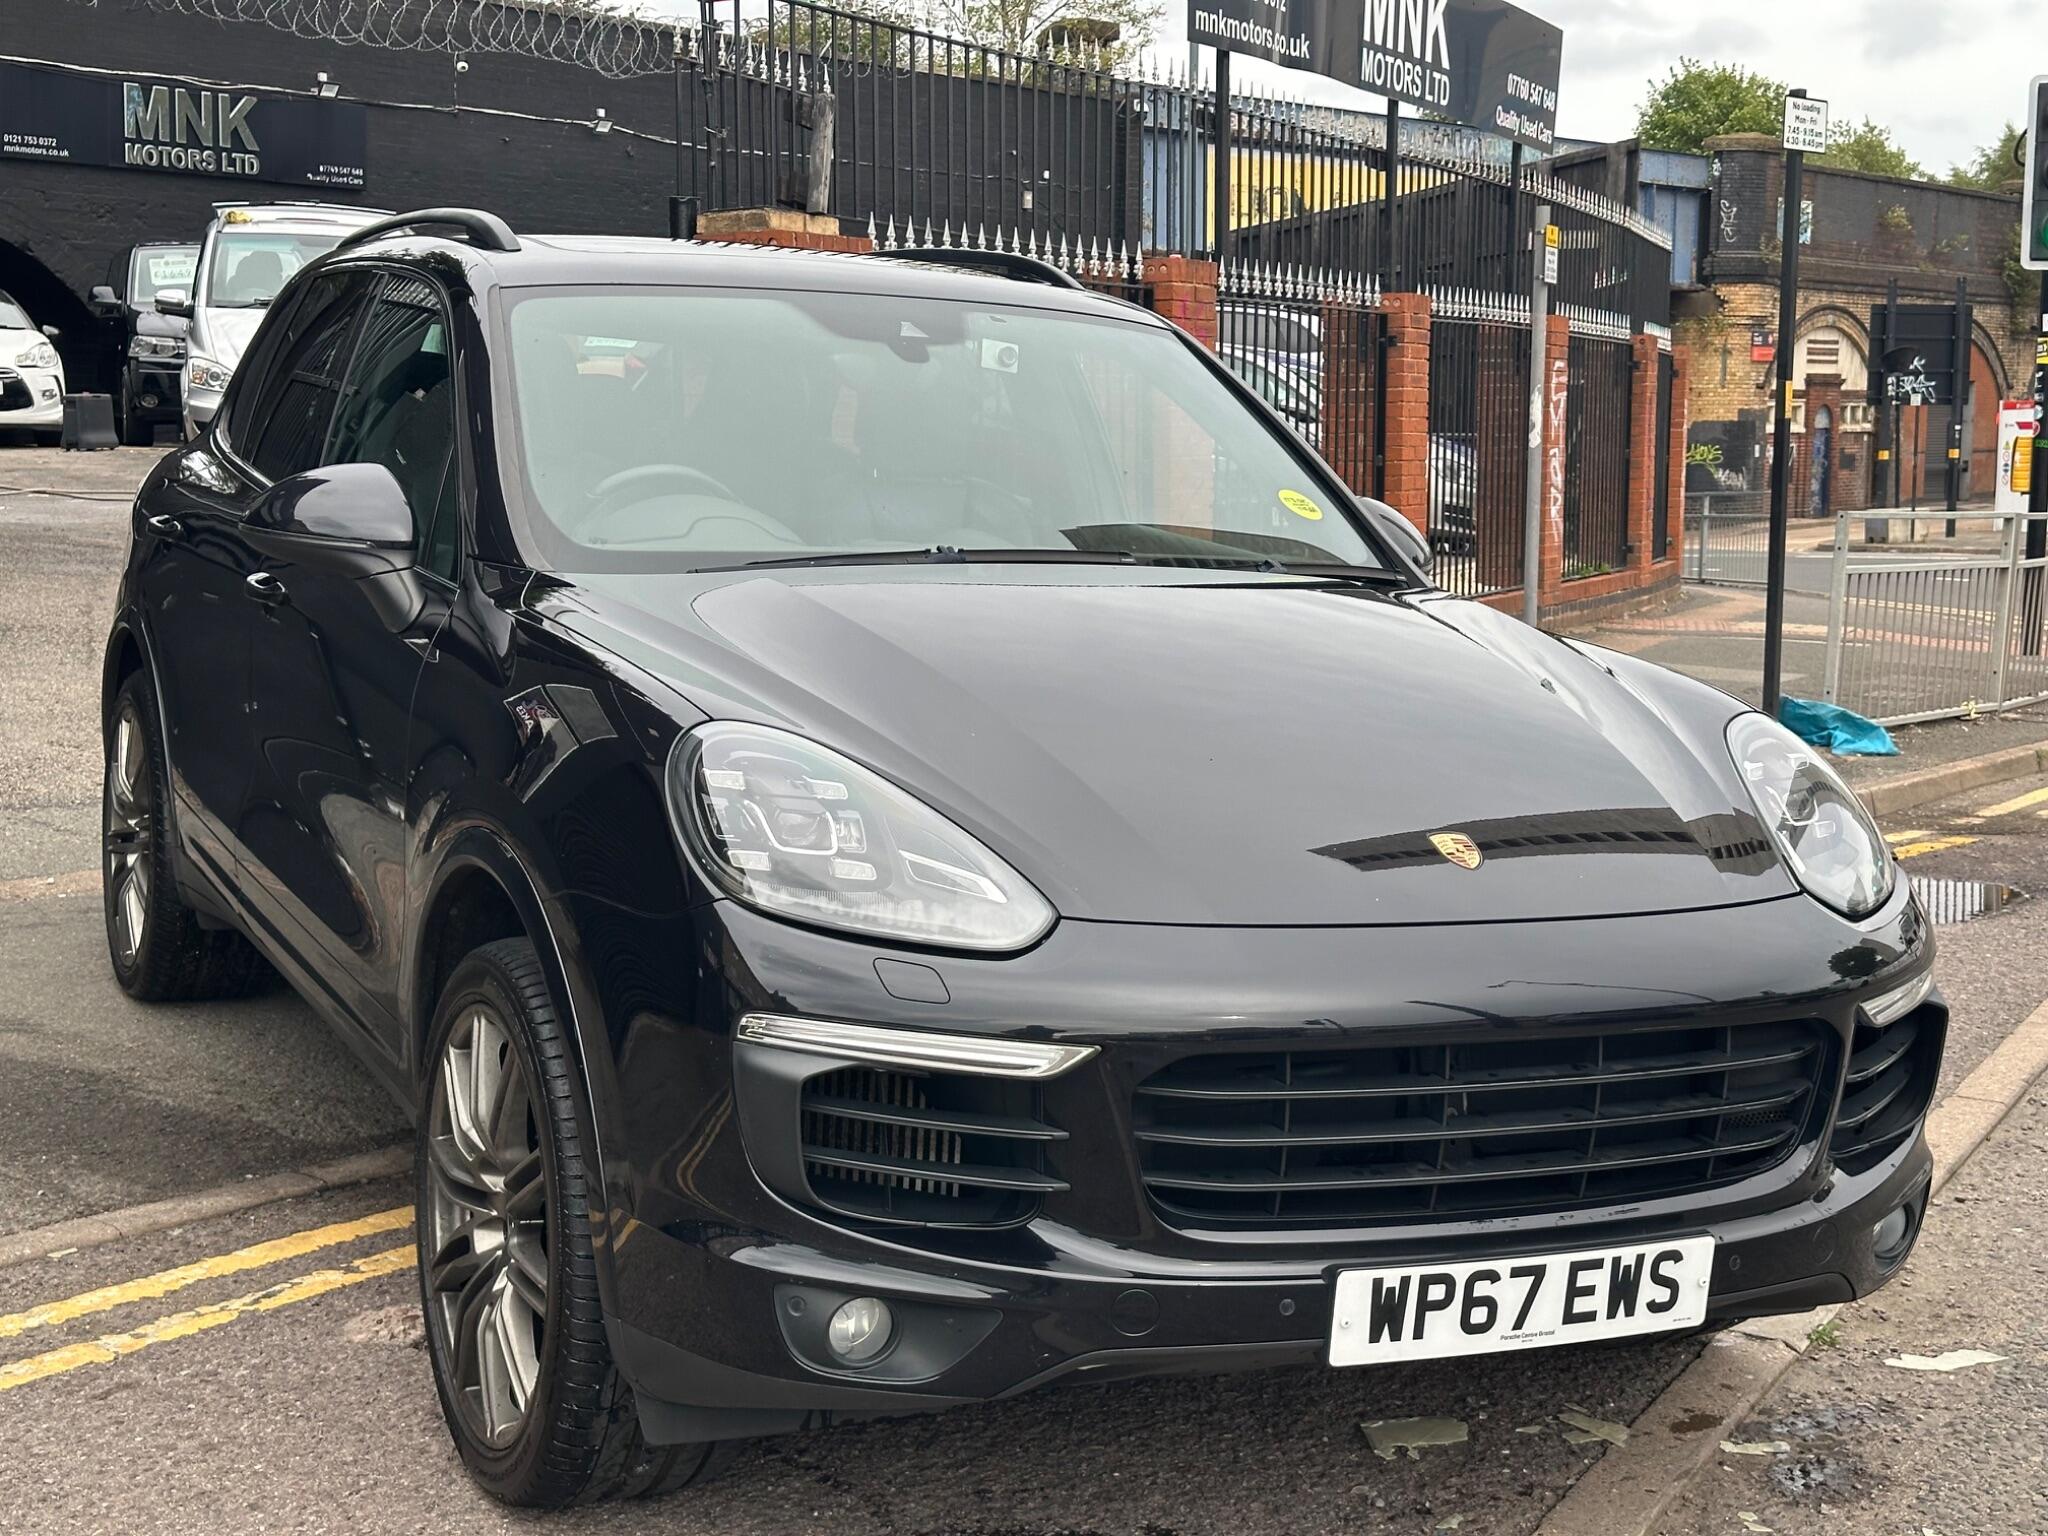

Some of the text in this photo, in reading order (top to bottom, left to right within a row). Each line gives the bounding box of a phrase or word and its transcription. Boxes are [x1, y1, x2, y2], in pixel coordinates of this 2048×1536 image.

[1195, 8, 1311, 59] mnkmotors.co.uk
[1363, 0, 1450, 70] MNK
[1361, 47, 1450, 106] MOTORS LTD
[1529, 82, 1544, 106] 547
[1542, 88, 1556, 113] 648
[1792, 101, 1820, 114] No loading
[123, 82, 260, 151] MNK
[1496, 104, 1553, 145] Quality Used Cars
[3, 134, 22, 143] 0121
[23, 135, 38, 145] 753
[3, 144, 69, 157] mnkmotors.co.uk
[125, 142, 260, 175] MOTORS LTD
[330, 175, 348, 183] Used
[348, 176, 363, 185] Cars
[1368, 1249, 1684, 1344] WP67 EWS
